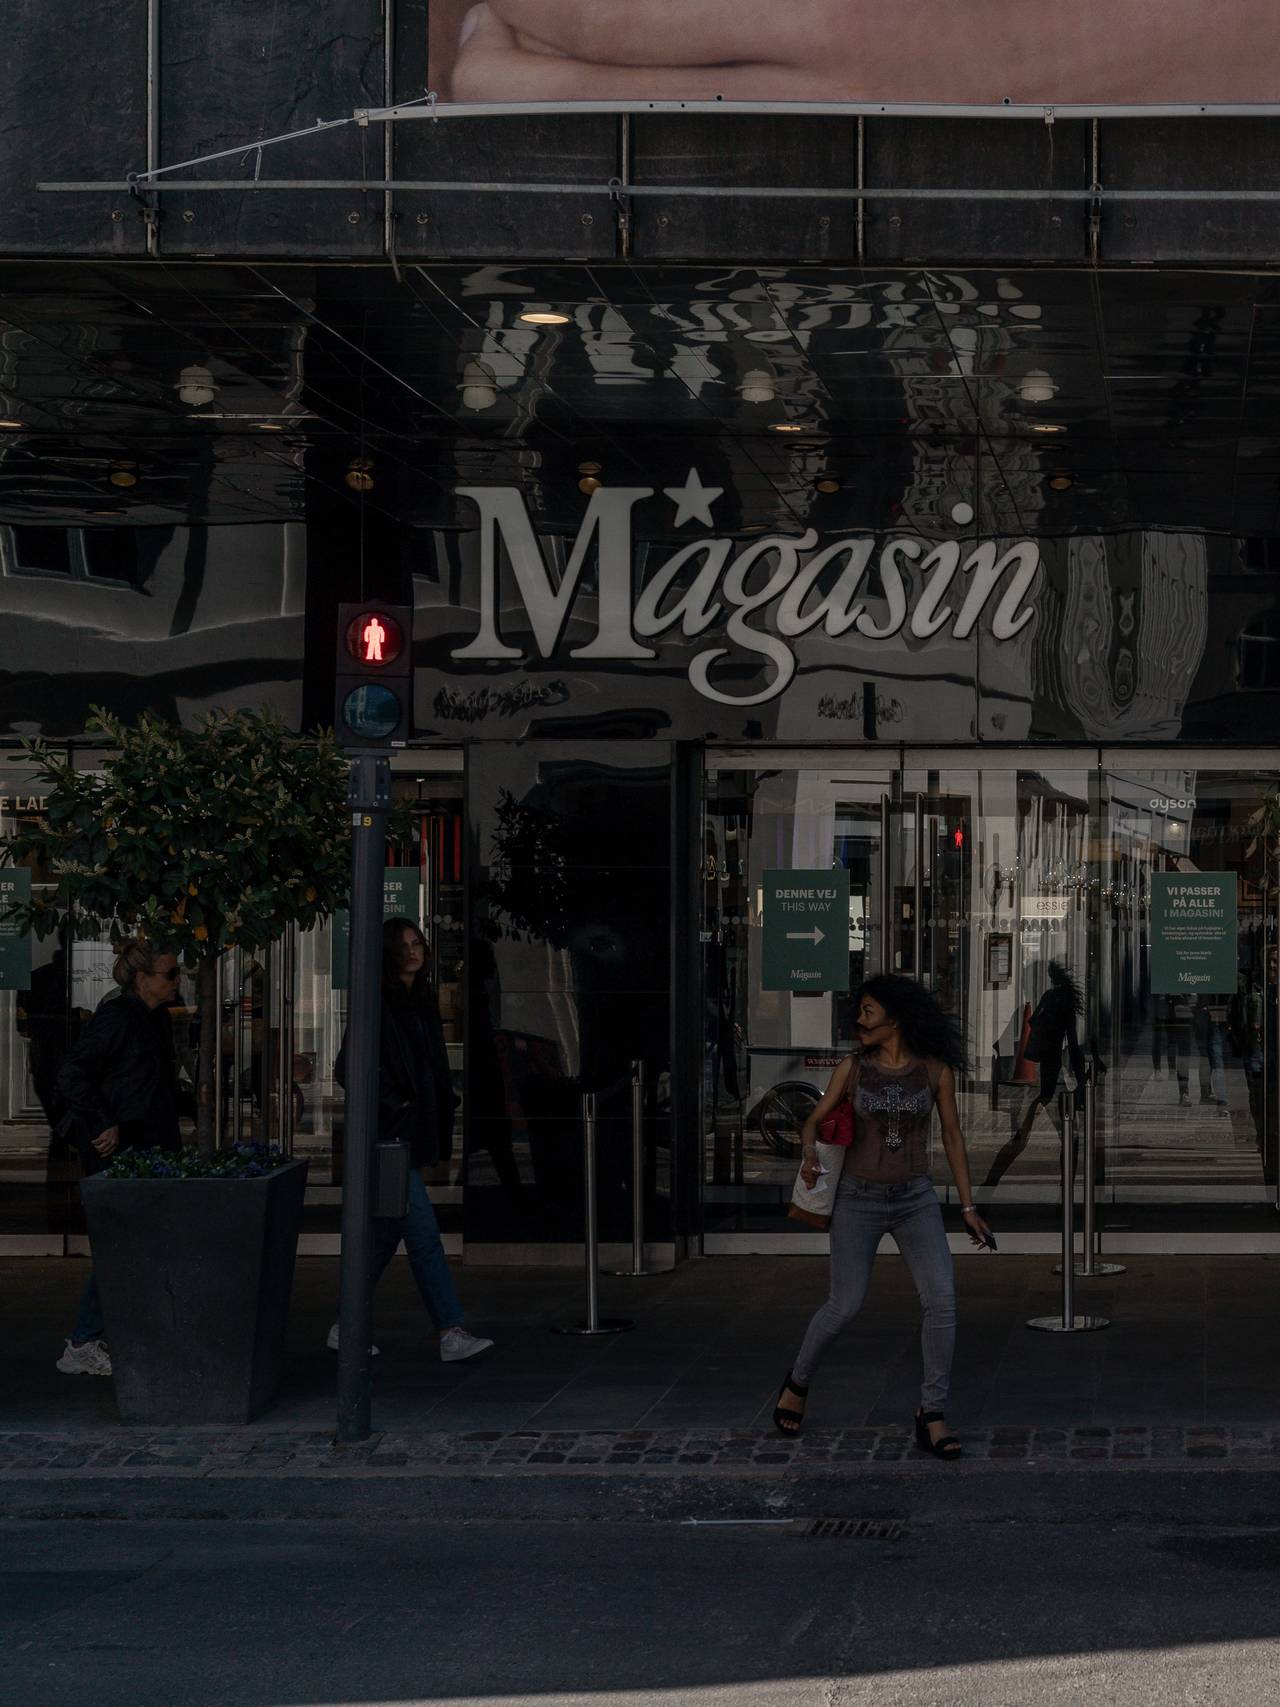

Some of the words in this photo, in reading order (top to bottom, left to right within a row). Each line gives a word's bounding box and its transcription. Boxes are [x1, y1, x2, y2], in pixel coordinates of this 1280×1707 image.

[450, 467, 1041, 706] Magasin
[1149, 797, 1197, 813] dyson
[775, 889, 815, 899] DENNE
[816, 889, 838, 899] VEJ
[1166, 886, 1178, 896] VI
[1180, 886, 1221, 896] PASSER
[781, 902, 806, 912] THIS
[808, 902, 832, 912] WAY
[1173, 896, 1187, 908] PÅ
[1188, 898, 1215, 908] ALLE
[1169, 908, 1225, 918] MAGASIN!
[790, 969, 823, 982] Magasin
[1177, 972, 1212, 984] Magasin
